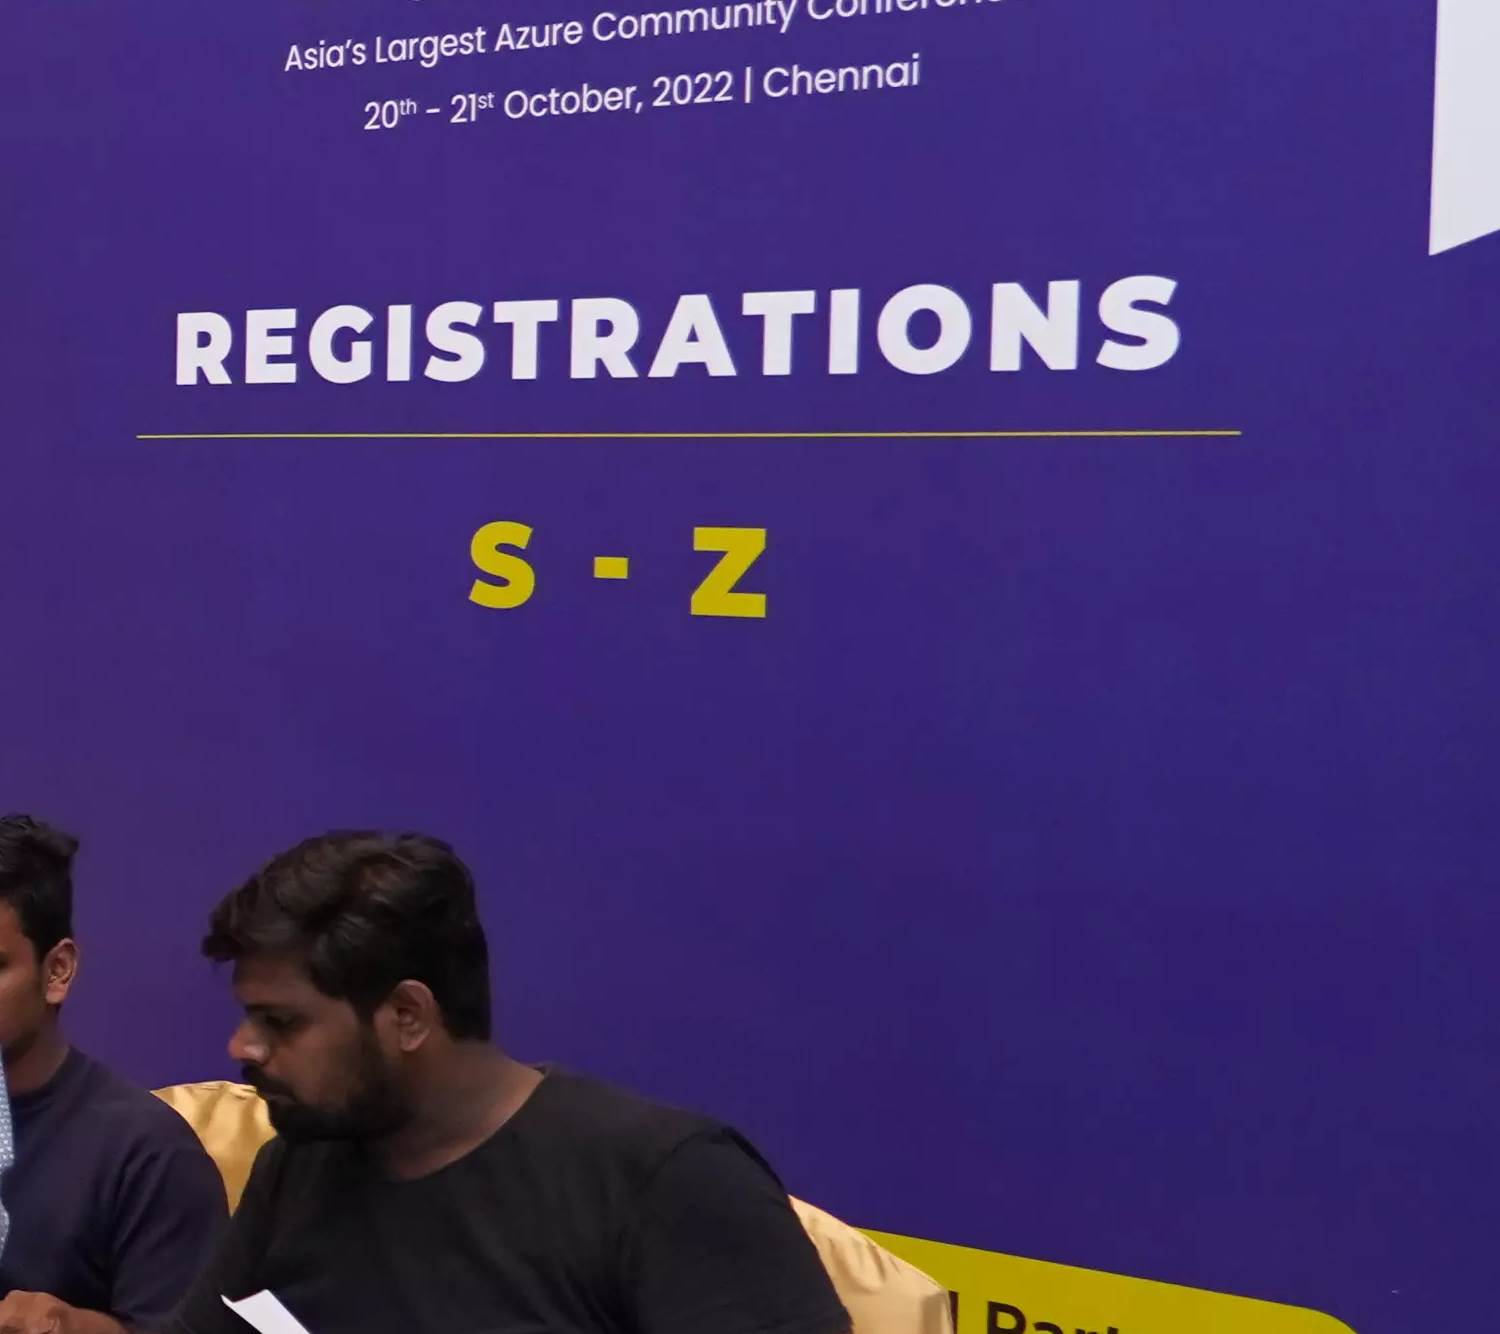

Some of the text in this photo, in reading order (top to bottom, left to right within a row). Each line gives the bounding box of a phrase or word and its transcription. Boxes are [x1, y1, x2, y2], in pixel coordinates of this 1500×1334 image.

[284, 37, 367, 72] Asia's
[375, 25, 487, 68] Largest
[495, 19, 584, 52] Azure
[363, 98, 418, 130] 20th
[450, 91, 496, 124] 21st
[503, 82, 643, 119] October,
[652, 70, 734, 108] 2022
[762, 52, 921, 98] Chennai
[174, 273, 1182, 386] REGISTRATIONS
[468, 520, 536, 609] S
[688, 525, 769, 618] Z
